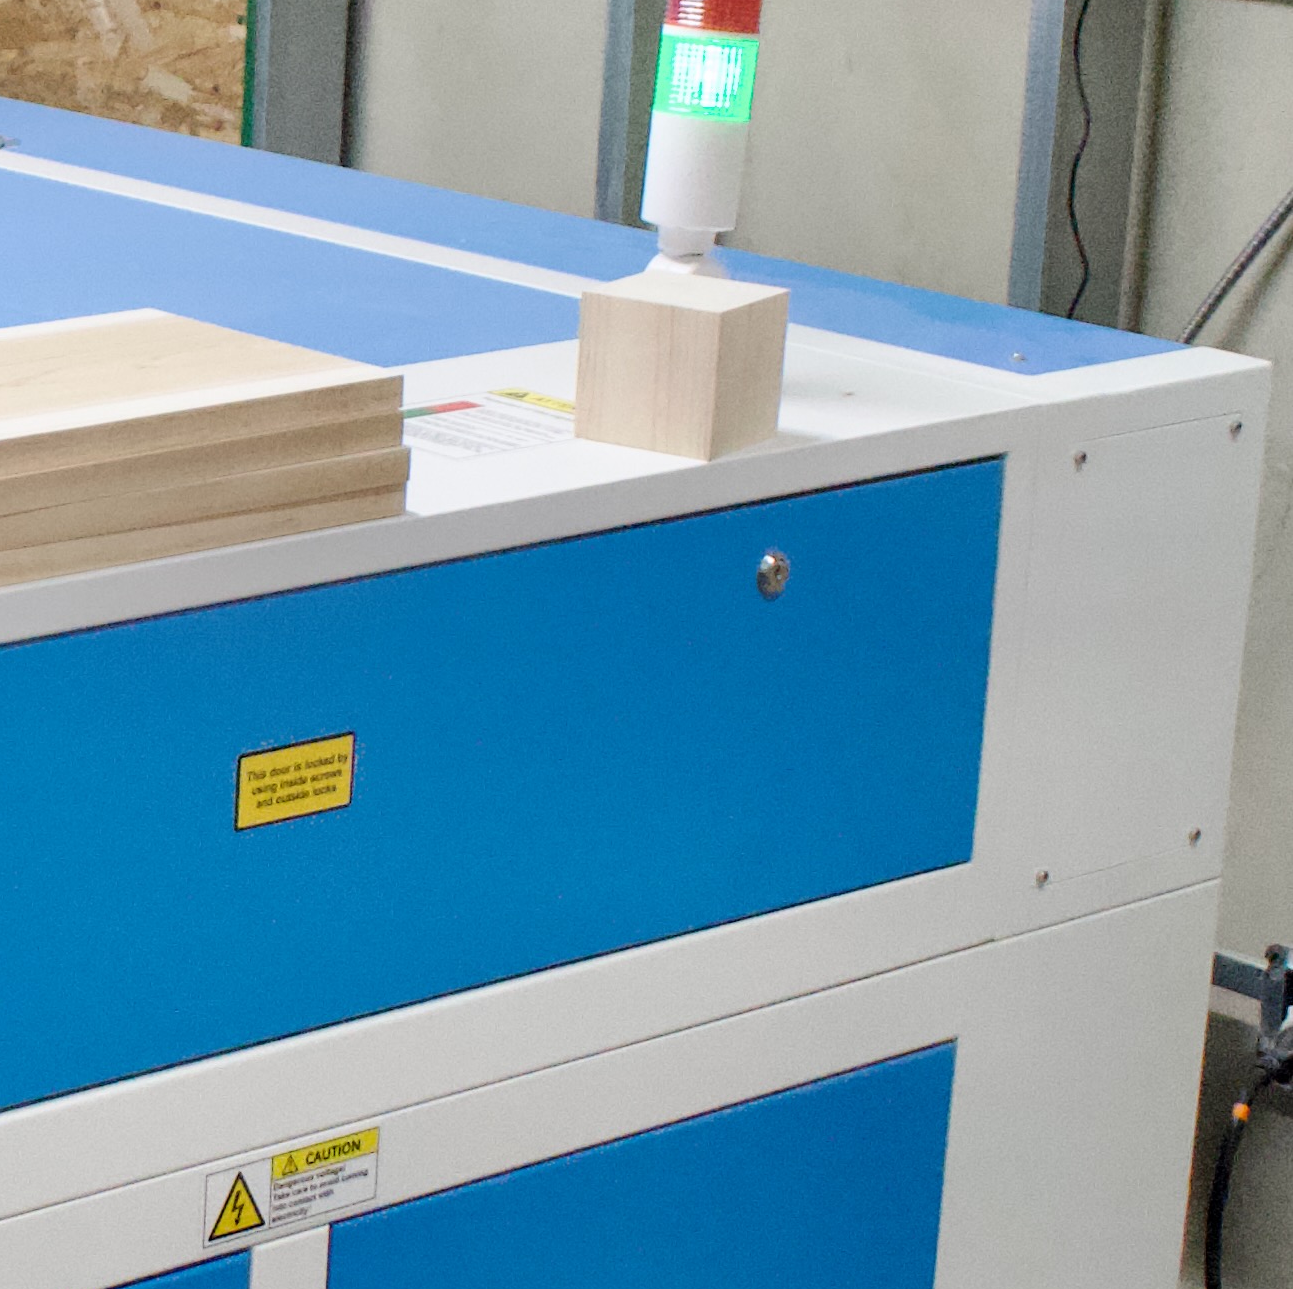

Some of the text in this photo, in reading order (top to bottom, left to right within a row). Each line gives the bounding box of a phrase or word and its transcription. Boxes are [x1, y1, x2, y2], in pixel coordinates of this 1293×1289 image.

[247, 770, 266, 782] This
[270, 766, 290, 777] door
[294, 762, 302, 771] is
[337, 753, 347, 764] by
[256, 797, 273, 808] and
[306, 1139, 361, 1165] CAUTION
